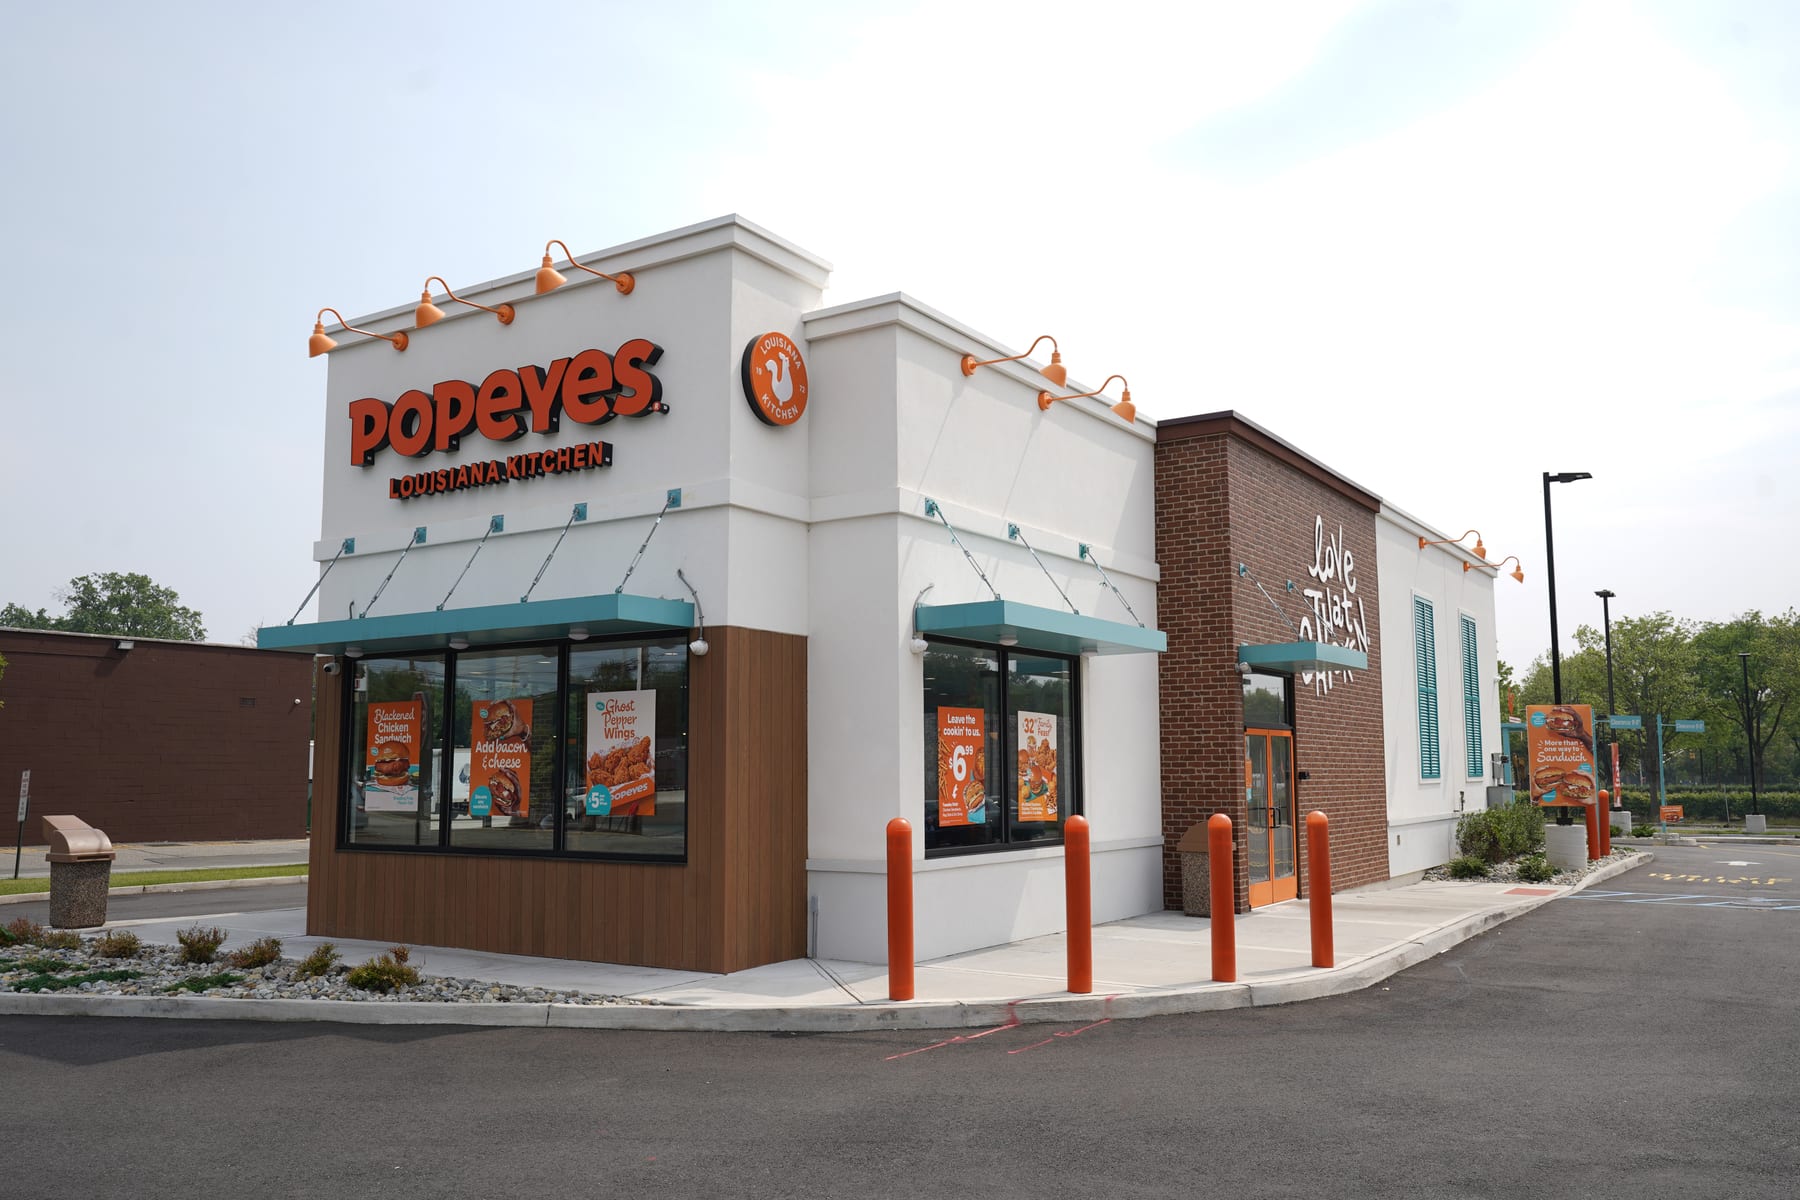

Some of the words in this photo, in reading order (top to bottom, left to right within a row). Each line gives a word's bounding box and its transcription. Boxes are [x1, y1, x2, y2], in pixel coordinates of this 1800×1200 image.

[760, 336, 801, 370] LOUISIANA
[762, 393, 799, 420] KITCHEN
[389, 459, 506, 501] LOUISIANA
[507, 441, 611, 482] KITCHEN
[606, 699, 635, 714] Ghost
[374, 706, 415, 724] Blackened
[602, 711, 637, 729] Pepper
[947, 714, 965, 725] Leave
[966, 715, 976, 725] the
[378, 722, 409, 733] Chicken
[604, 728, 636, 740] Wings
[943, 725, 965, 737] cookin'
[965, 727, 972, 736] to
[972, 728, 981, 737] us.
[374, 733, 412, 744] Sandwich
[475, 741, 494, 753] Add
[495, 739, 528, 753] bacon
[488, 753, 521, 769] cheese
[1536, 751, 1588, 763] Sandwich
